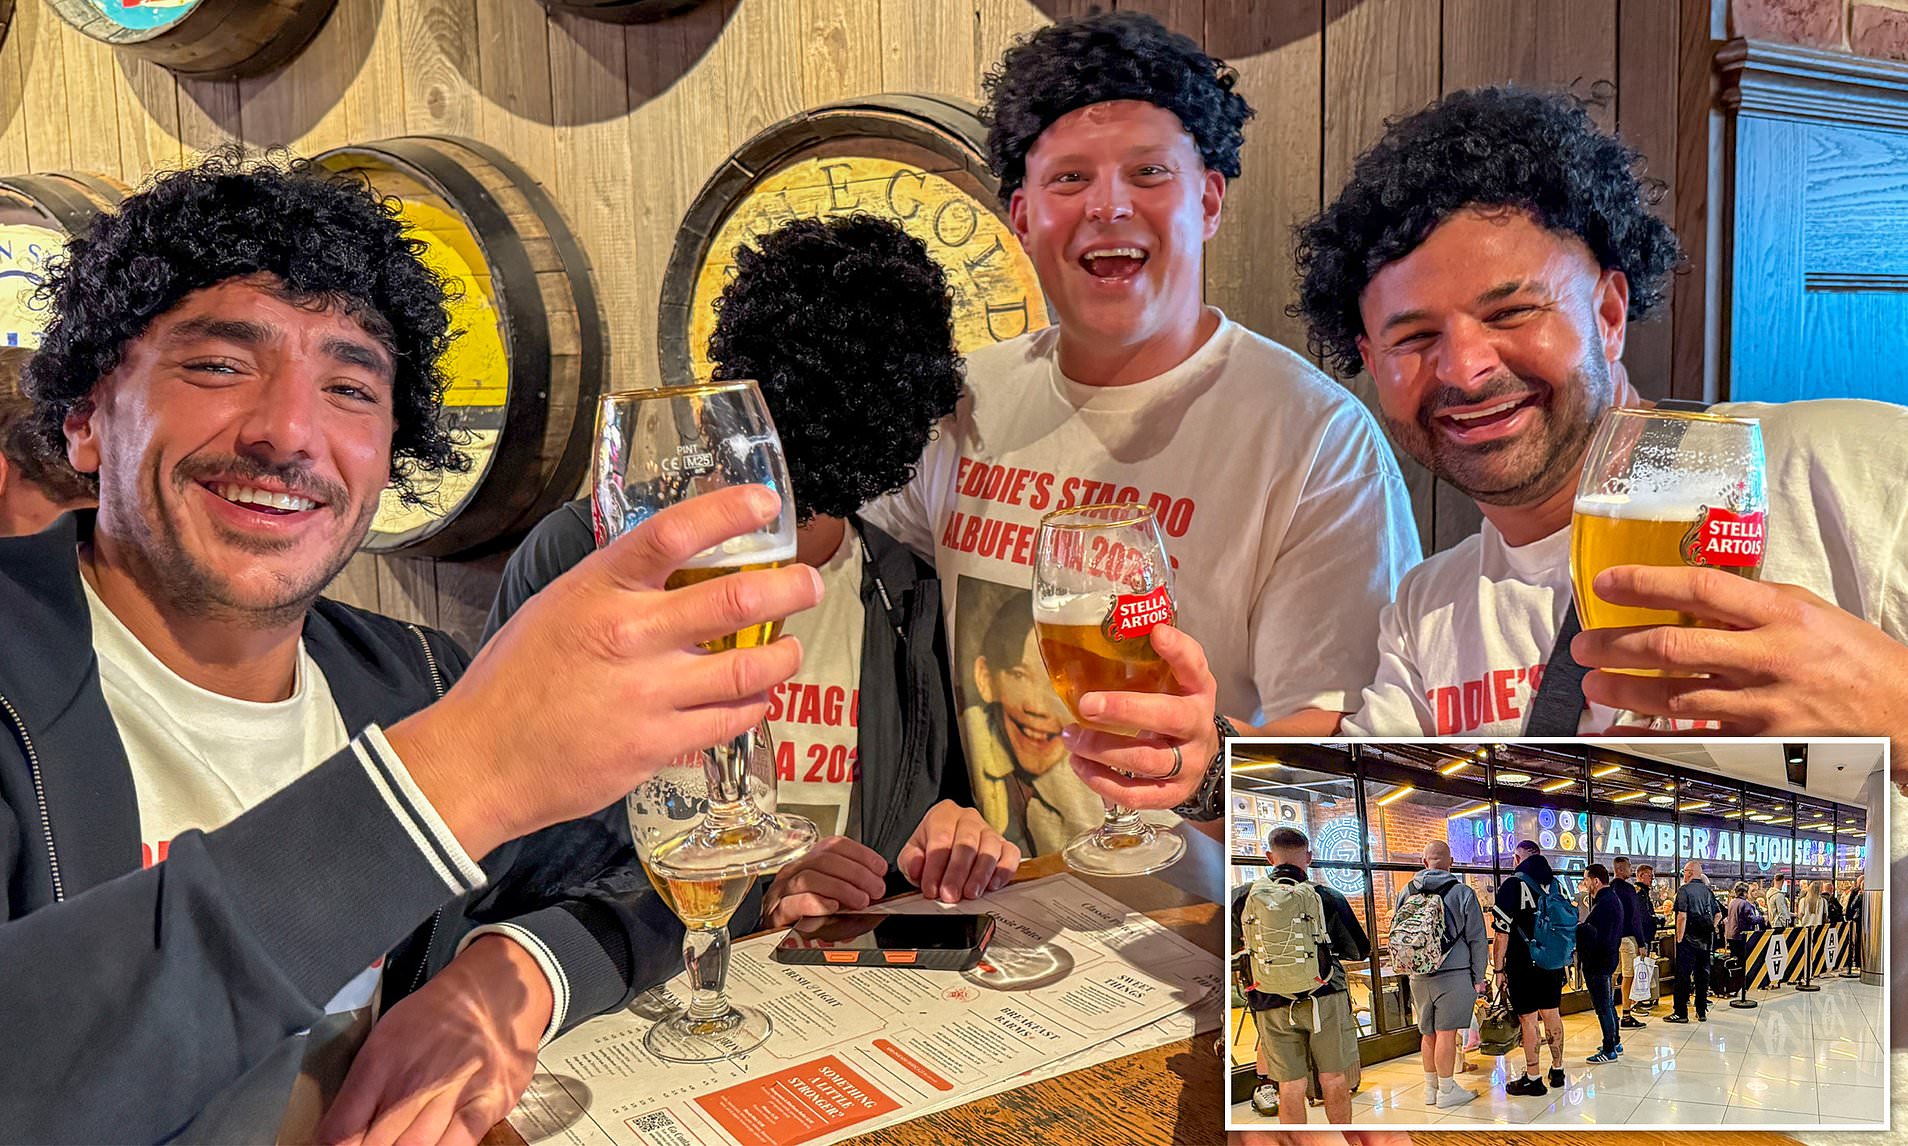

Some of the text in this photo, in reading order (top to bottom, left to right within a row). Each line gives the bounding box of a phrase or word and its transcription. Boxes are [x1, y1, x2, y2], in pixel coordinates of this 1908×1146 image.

[677, 444, 697, 455] PINT
[686, 454, 712, 468] M25
[954, 456, 1196, 538] EDDIE'S STAG DO
[1709, 520, 1763, 538] STELLA
[1705, 537, 1762, 555] ARTOIS
[1120, 595, 1167, 616] STELLA
[1121, 607, 1168, 630] ARTOIS
[766, 681, 845, 727] STAG
[1325, 829, 1361, 850] SEVE
[1605, 819, 1811, 869] AMBER ALEHOUSE
[1081, 902, 1110, 920] Classic
[1015, 923, 1043, 942] Plates
[782, 967, 811, 986] FRESH
[813, 989, 843, 1007] LIGHT
[1104, 978, 1146, 999] THINGS
[1117, 974, 1156, 993] SWEET
[994, 1015, 1033, 1037] BARMS
[1000, 1007, 1061, 1040] BREAKFAST
[788, 1077, 845, 1118] STRONGER?
[816, 1082, 855, 1109] LITTLE
[818, 1066, 878, 1109] SOMETHING
